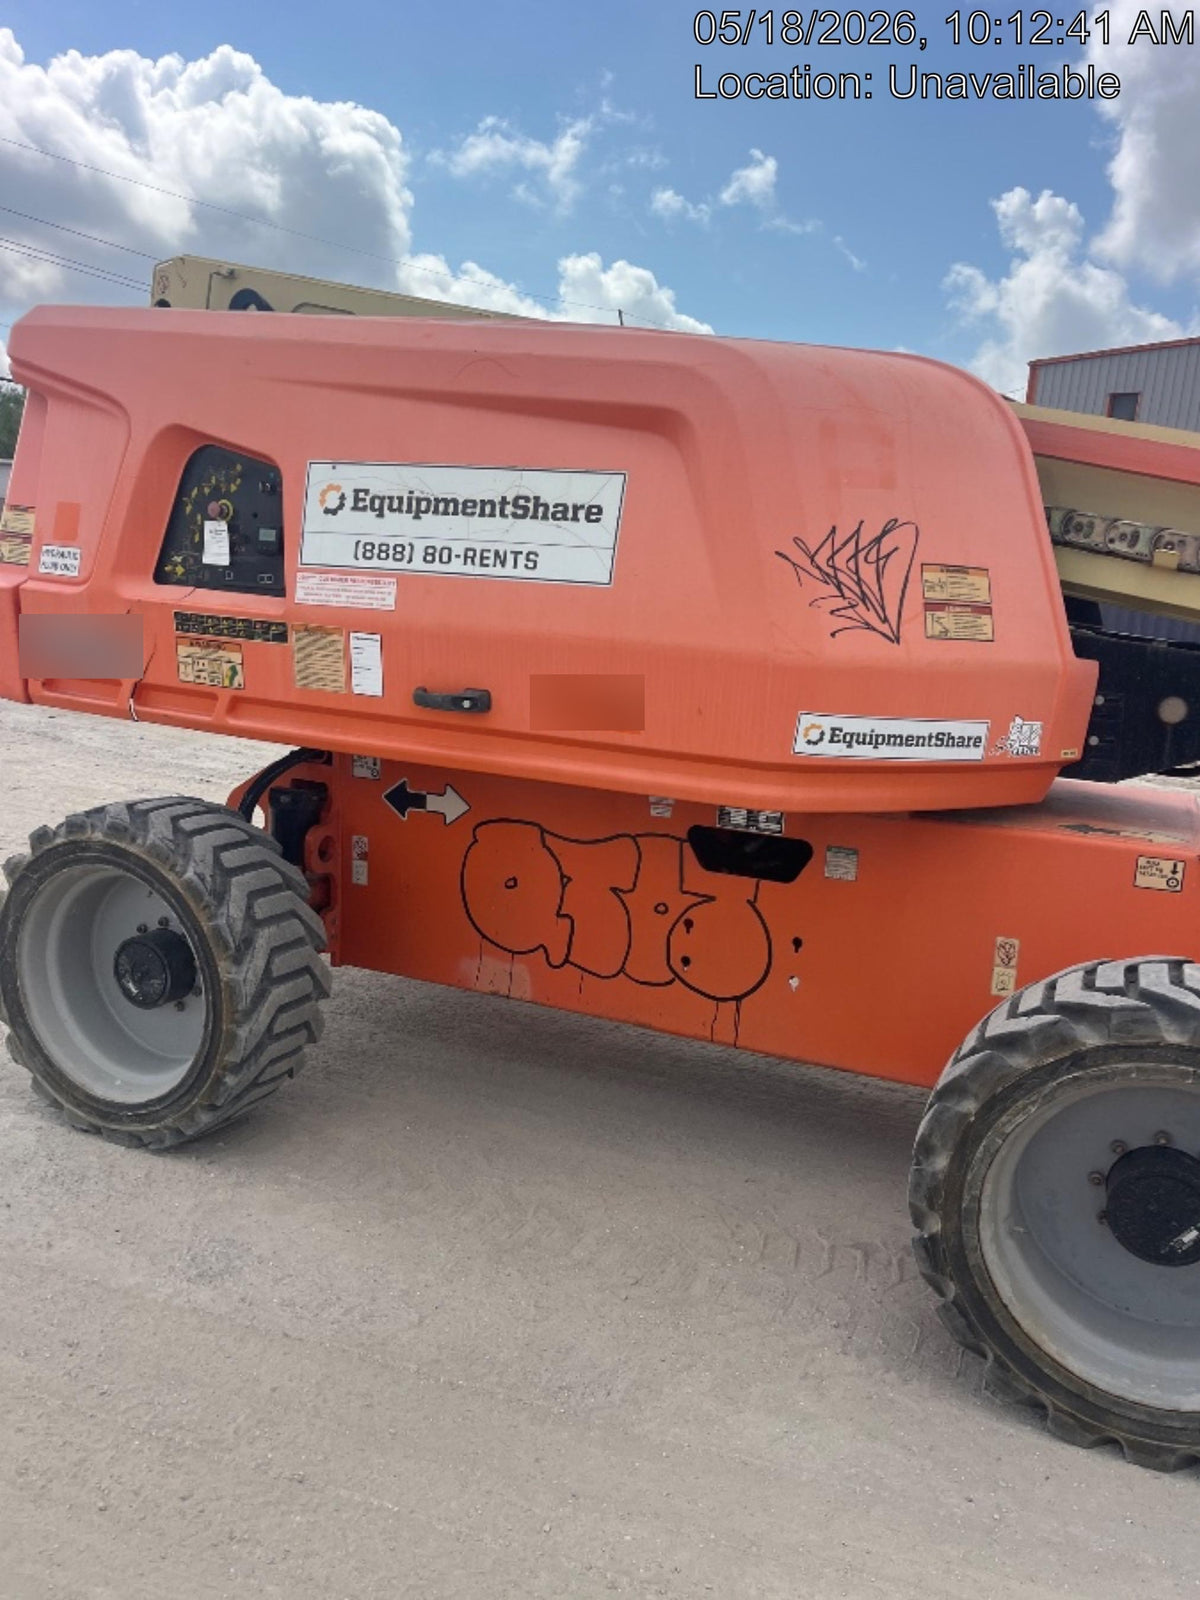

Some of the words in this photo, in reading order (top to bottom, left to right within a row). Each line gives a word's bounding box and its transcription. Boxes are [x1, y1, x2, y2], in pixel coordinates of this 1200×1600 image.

[350, 488, 604, 524] EquipmentShare
[353, 540, 414, 564] (888)
[422, 545, 540, 570] 80-RENTS
[828, 726, 984, 750] EquipmentShare
